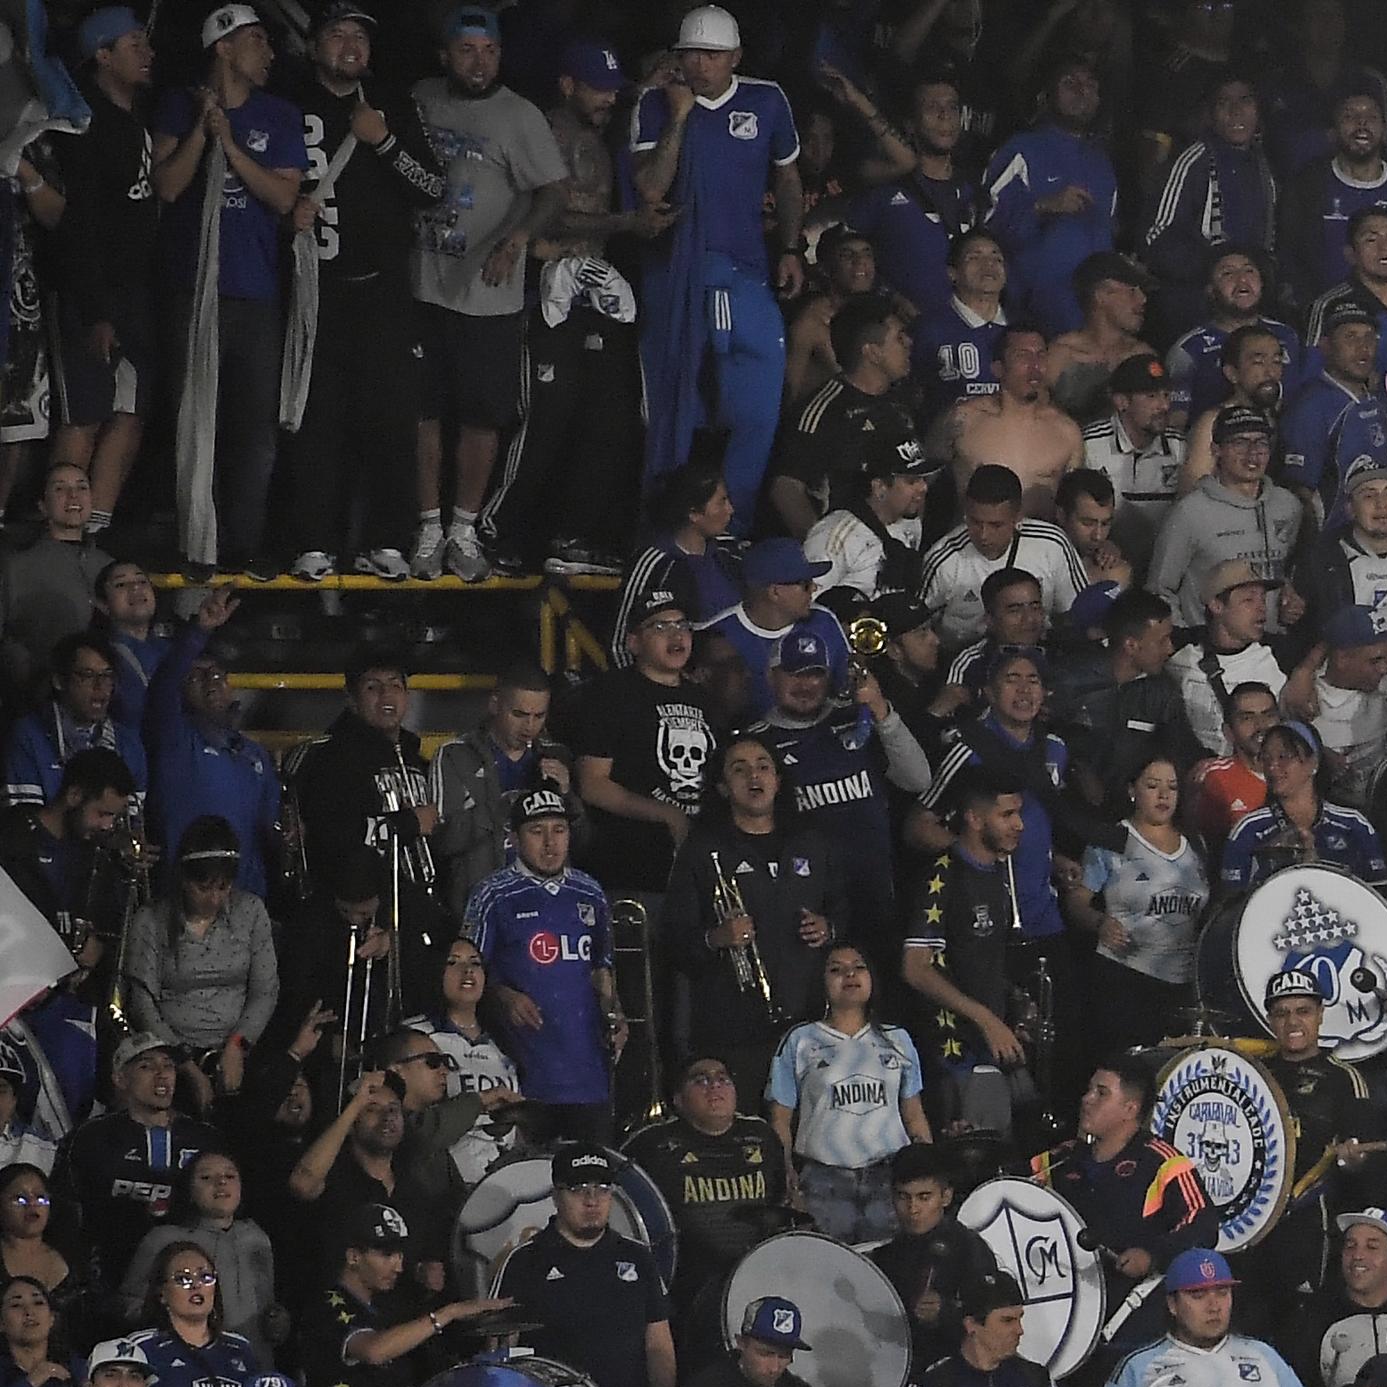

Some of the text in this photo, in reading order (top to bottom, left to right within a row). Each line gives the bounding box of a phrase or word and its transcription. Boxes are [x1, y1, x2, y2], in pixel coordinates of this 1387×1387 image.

[937, 344, 981, 381] 10
[796, 769, 874, 812] ANDINA
[561, 935, 593, 964] LG
[832, 1082, 889, 1111] ANDINA
[1165, 1077, 1245, 1131] INSTRUMENTAL
[571, 1154, 610, 1169] adidas
[683, 1170, 768, 1204] ANDINA
